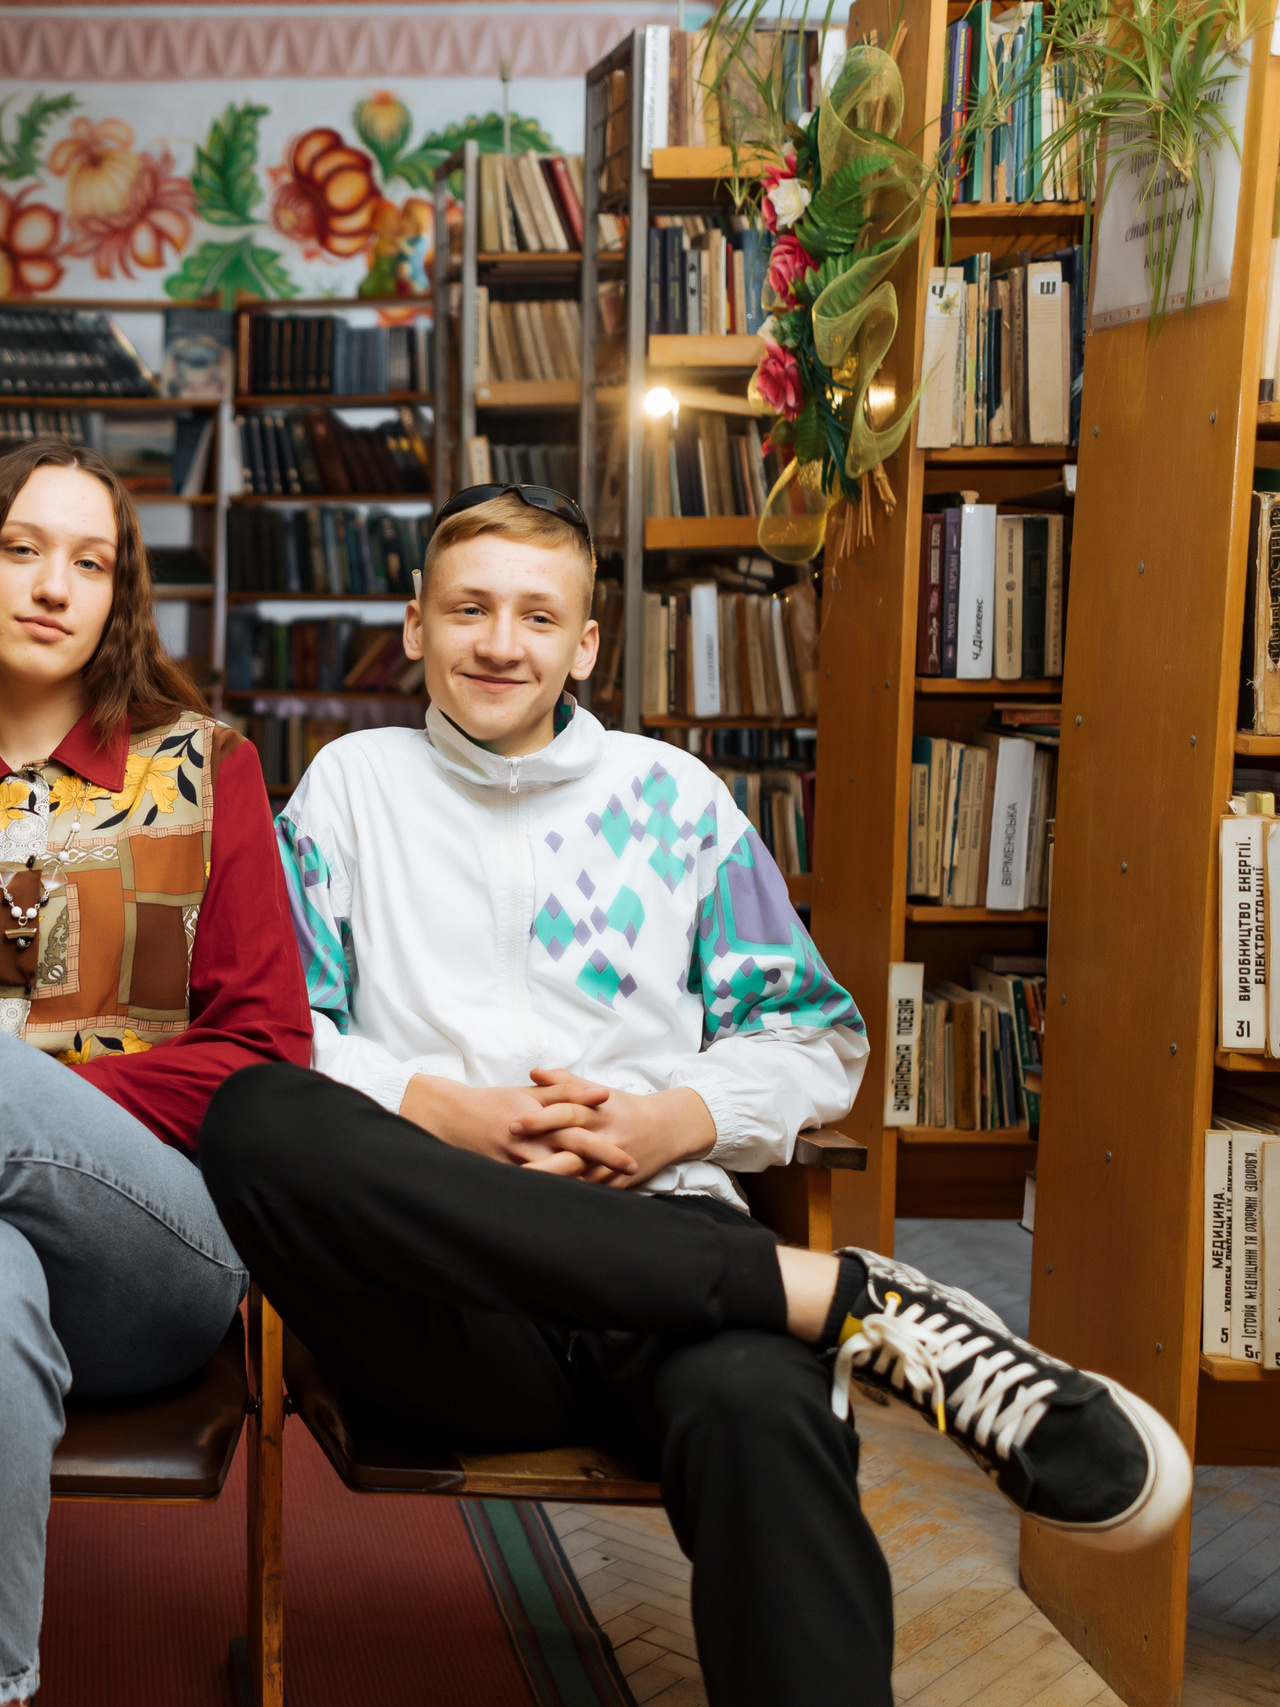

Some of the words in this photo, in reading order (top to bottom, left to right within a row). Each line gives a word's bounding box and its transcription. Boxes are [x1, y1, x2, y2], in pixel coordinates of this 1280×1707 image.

[1040, 281, 1056, 294] Ш
[972, 598, 984, 661] Ч.Діккенс
[1000, 801, 1018, 887] ВІРМЕНСЬКА
[1234, 835, 1251, 892] ЕНЕРГІЇ.
[1238, 902, 1253, 1002] ВИРОБНИЦТВО
[896, 997, 914, 1035] ПОЕЗІЯ
[1235, 1020, 1250, 1038] 31
[891, 1044, 914, 1112] УКРАЇНСЬКА
[1211, 1188, 1226, 1269] МЕДИЦИНА.
[1244, 1235, 1257, 1246] ТА
[1220, 1327, 1229, 1344] 5
